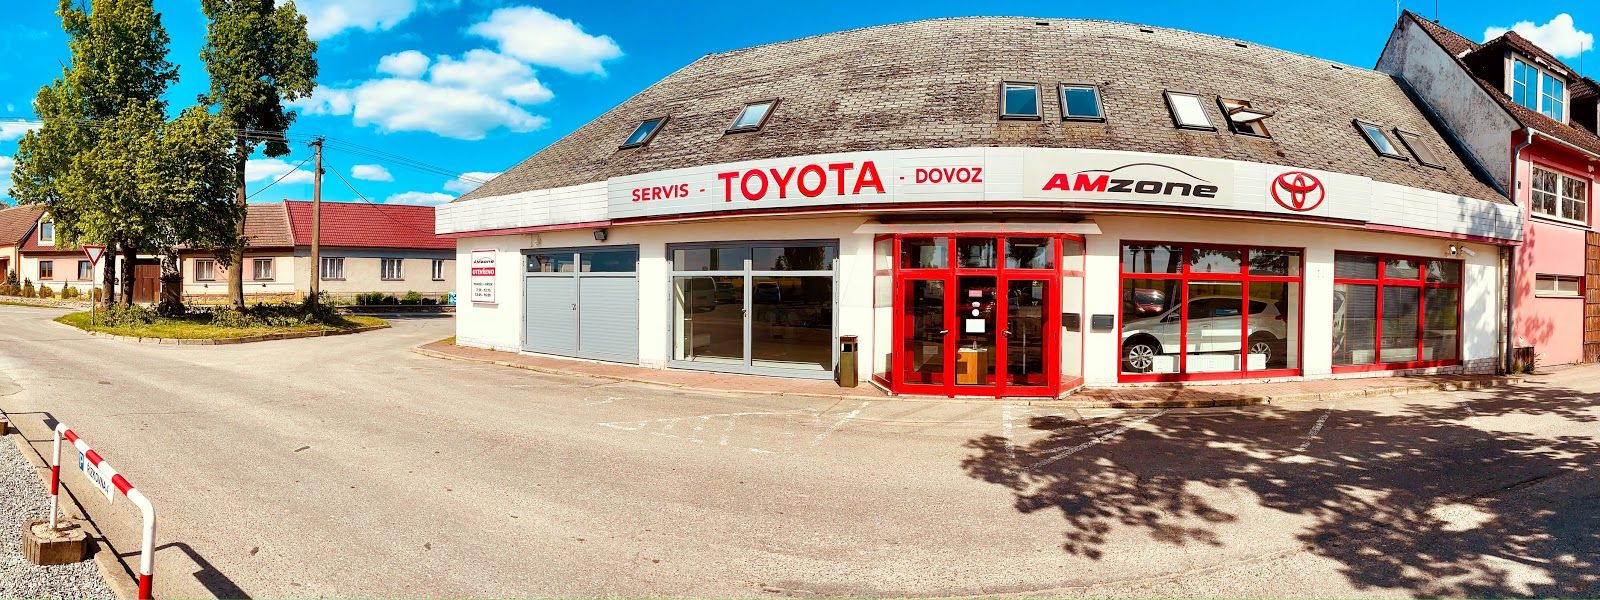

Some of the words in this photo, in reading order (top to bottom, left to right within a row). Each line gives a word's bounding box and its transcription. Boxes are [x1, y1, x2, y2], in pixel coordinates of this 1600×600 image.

[632, 183, 689, 202] SERVIS
[717, 160, 887, 203] TOYOTA
[915, 167, 983, 184] DOVOZ
[1041, 173, 1219, 199] AMzone
